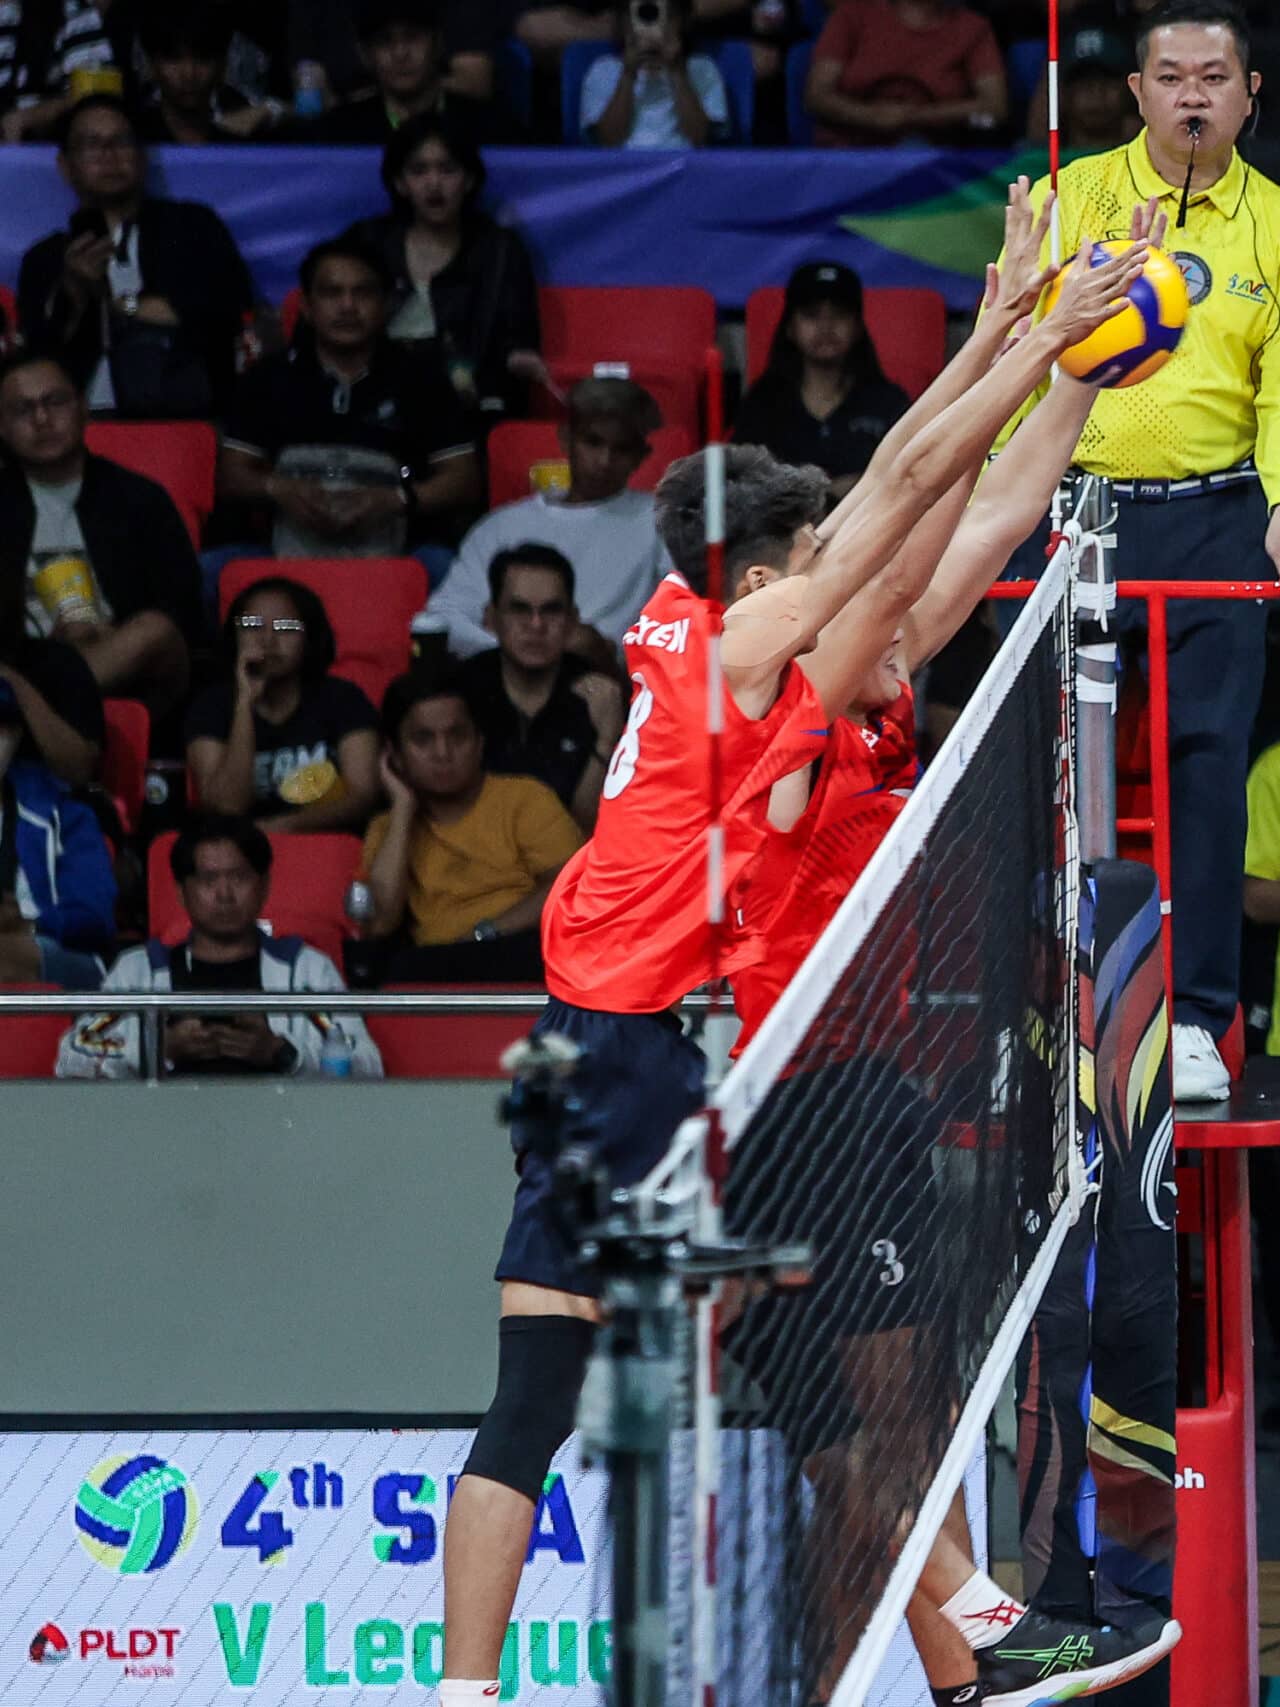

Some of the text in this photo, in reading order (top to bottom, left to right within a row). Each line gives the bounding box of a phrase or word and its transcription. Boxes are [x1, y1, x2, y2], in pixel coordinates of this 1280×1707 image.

[872, 1239, 904, 1285] 3
[221, 1462, 585, 1565] 4th SA
[80, 1629, 180, 1660] PLDT
[213, 1602, 272, 1687] V
